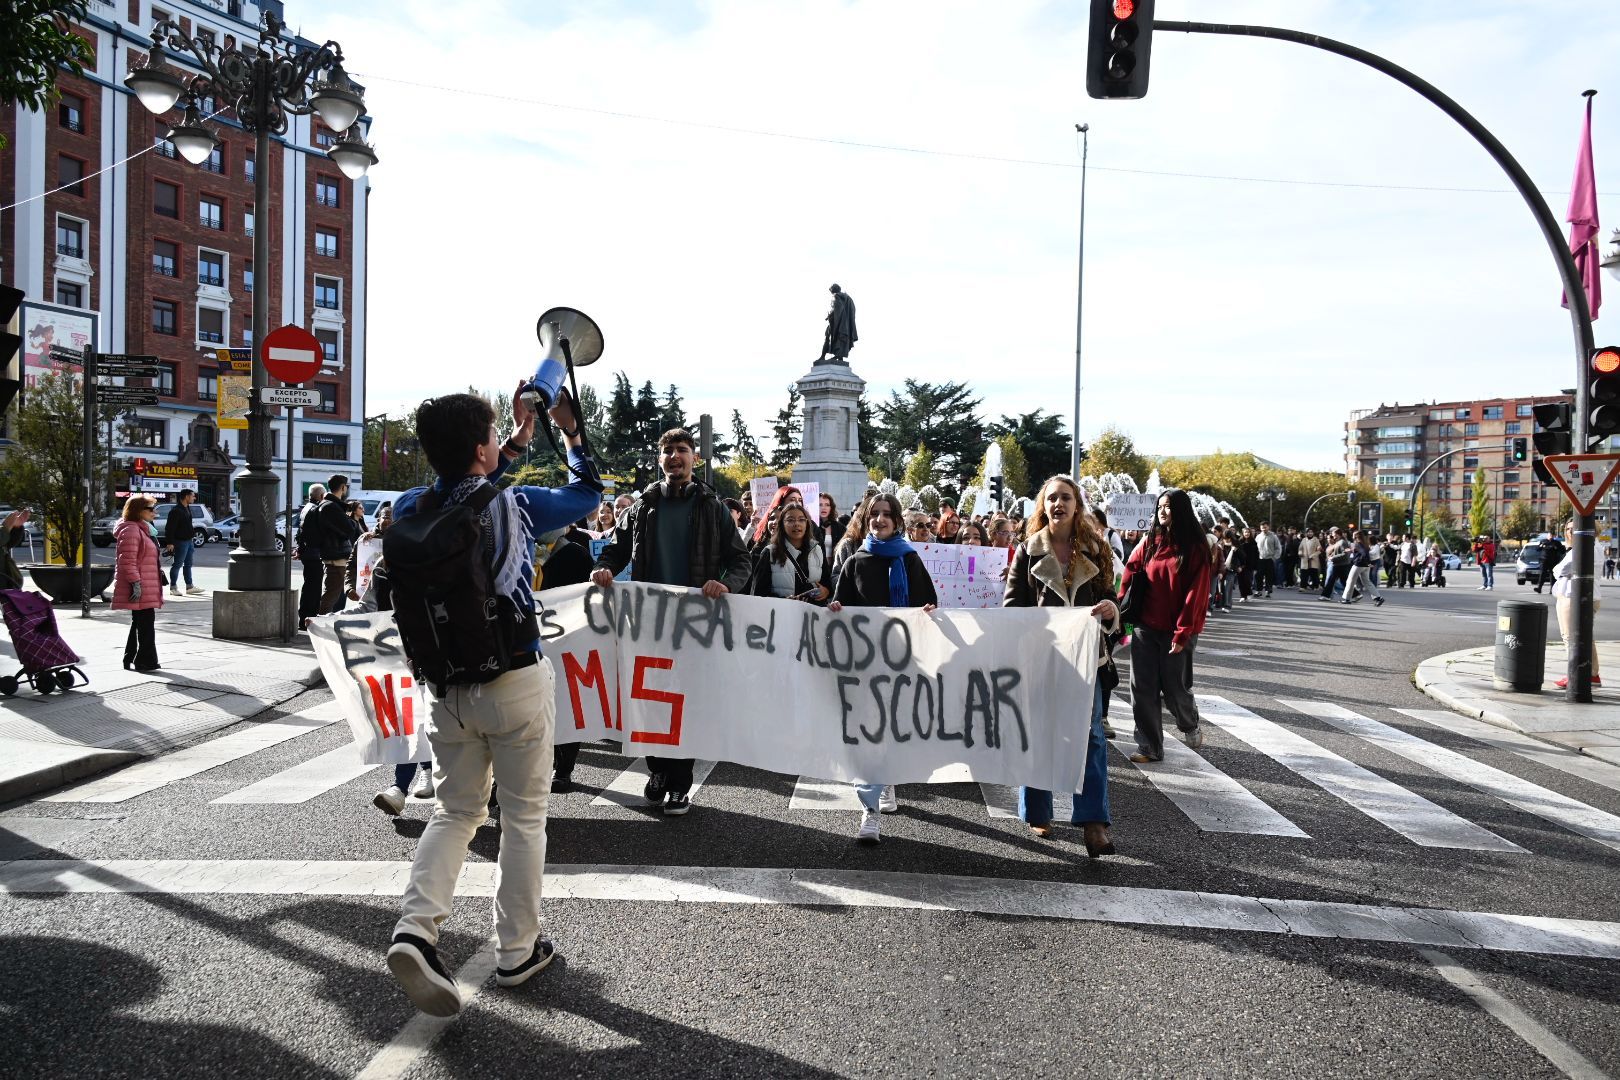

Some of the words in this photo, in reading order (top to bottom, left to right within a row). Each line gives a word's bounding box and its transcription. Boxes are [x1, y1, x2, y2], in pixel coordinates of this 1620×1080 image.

[274, 389, 308, 397] EXCEPTO
[152, 465, 195, 475] TABACOS
[745, 608, 776, 654] el
[795, 611, 913, 672] ACOSO
[837, 667, 1029, 752] ESCOLAR
